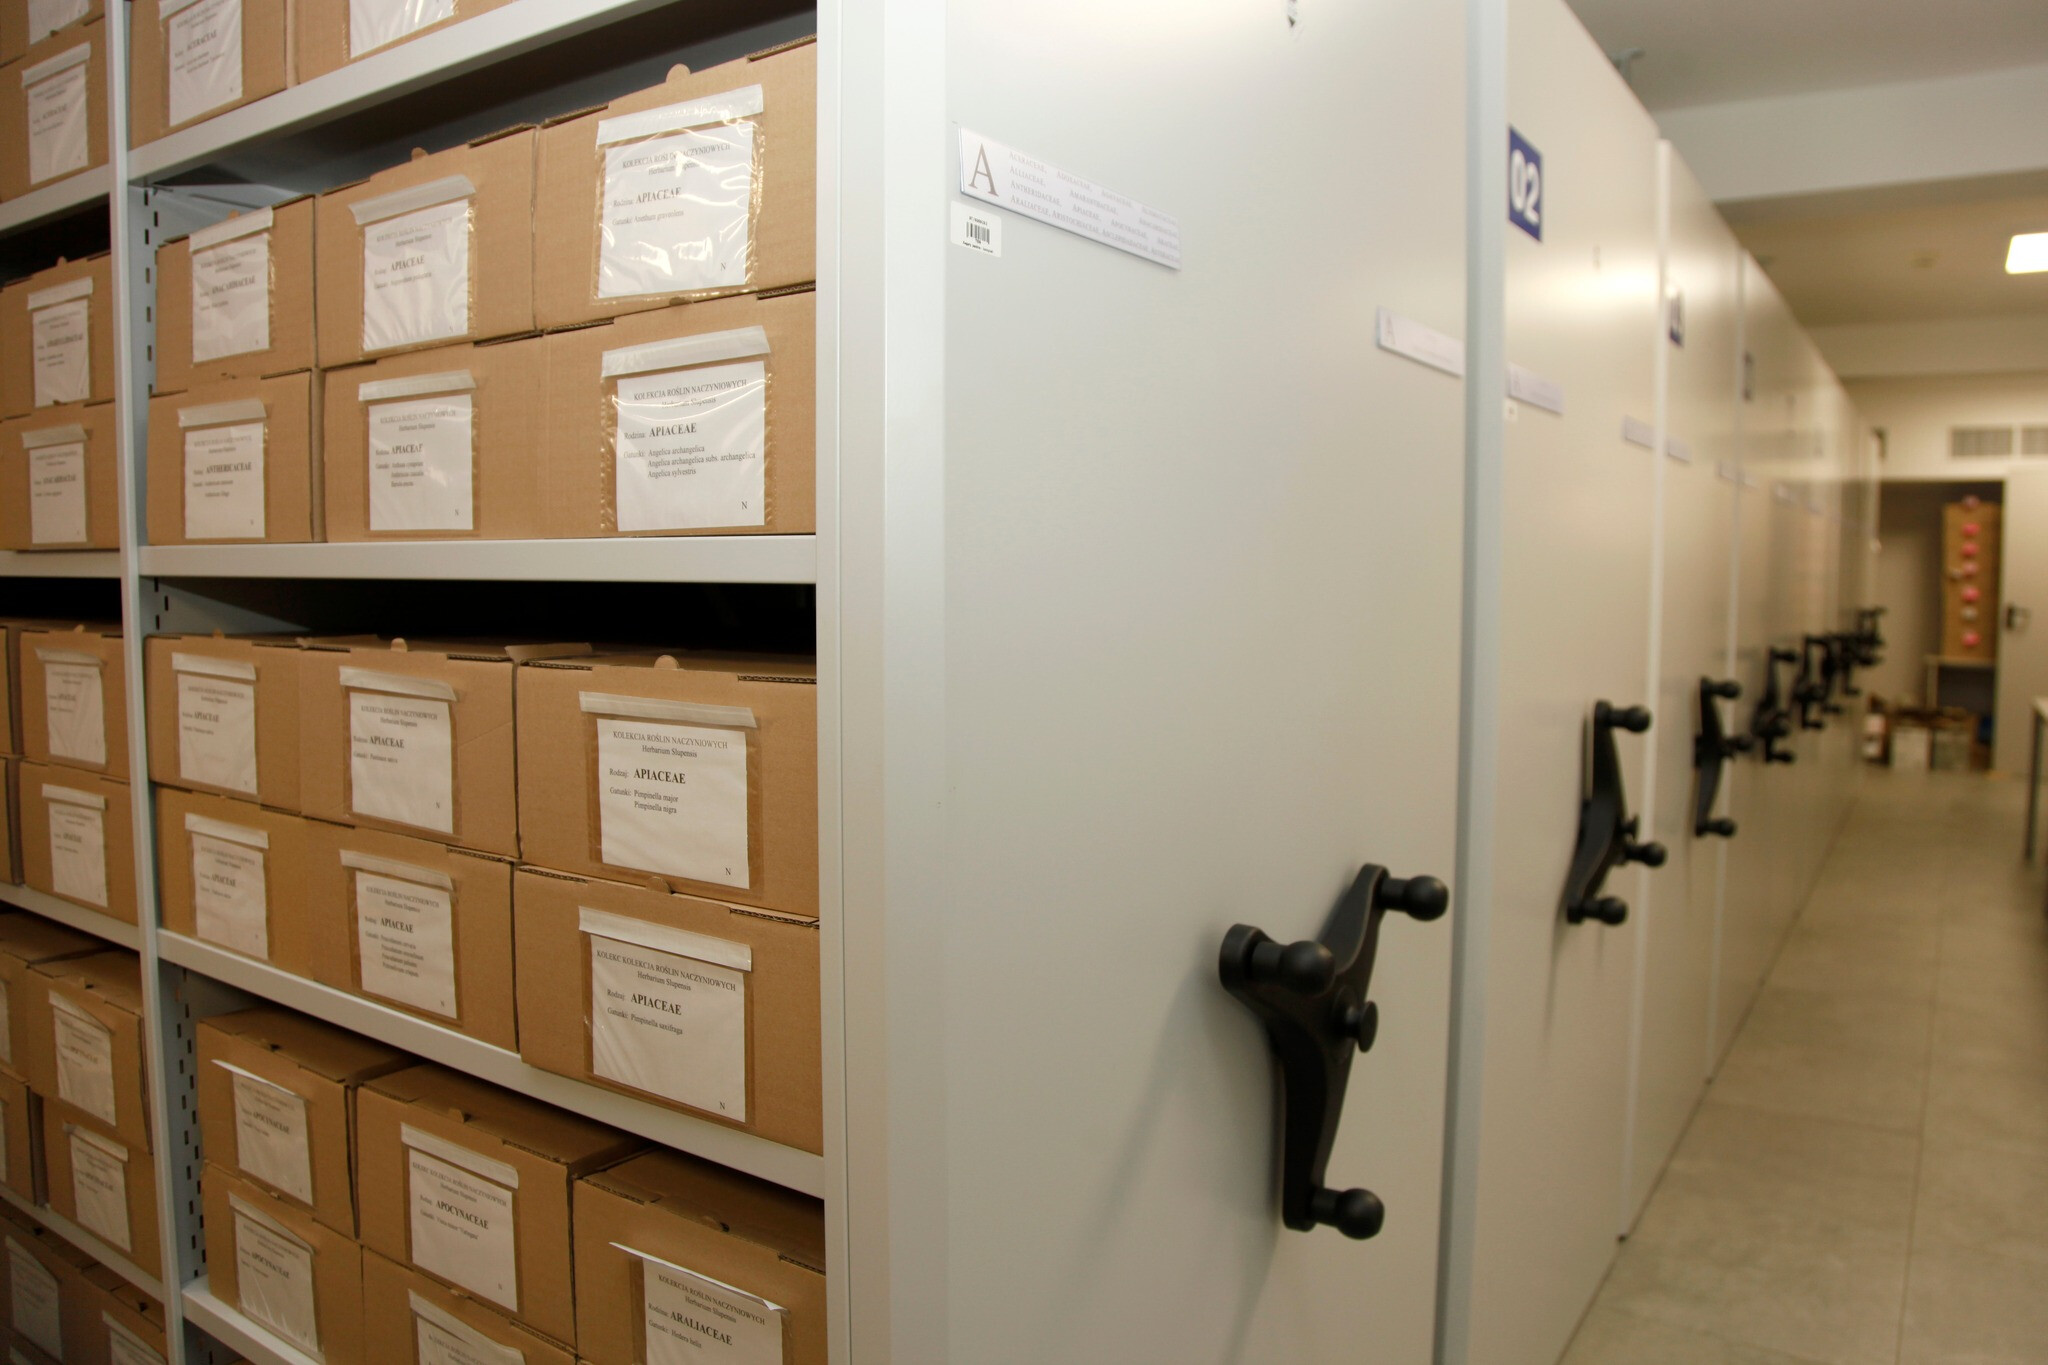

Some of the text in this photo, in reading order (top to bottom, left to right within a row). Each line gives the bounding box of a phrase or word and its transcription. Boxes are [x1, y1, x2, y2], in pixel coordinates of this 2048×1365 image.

[968, 143, 999, 197] A
[1511, 148, 1540, 224] 02
[636, 187, 682, 204] APIACEAE
[390, 255, 425, 272] APIACEAE
[720, 262, 727, 272] N
[634, 379, 747, 401] KOLEKCJA ROŚLIN NACZYNIOWYCH
[649, 423, 697, 437] APIACEAE
[391, 443, 424, 455] APIACEAE
[648, 449, 671, 459] Angelica
[671, 444, 705, 457] archangelica
[647, 451, 756, 469] Angelica archangelica subs. archangelica
[647, 467, 697, 480] Angelica sylvestris
[741, 501, 748, 510] N
[369, 735, 405, 749] APIACEAE
[613, 730, 728, 750] KOLEKCJA ROŚLIN NACZYNIOWYCH
[642, 744, 698, 759] Herbarium Slupensis
[609, 768, 686, 785] Rodzaj: APIACEAE
[633, 789, 662, 801] Pimpinella
[662, 792, 679, 804] major
[633, 800, 677, 815] Pimpinella nigra
[725, 867, 732, 876] N
[380, 917, 414, 935] APIACEAE
[596, 950, 736, 992] KOLEKC KOLEKCJA ROŚLIN NACZYNIOWYCH
[637, 971, 665, 986] Herbarium
[630, 993, 682, 1015] APIACEAE
[630, 1013, 658, 1029] Pimpinella
[659, 1020, 683, 1036] saxifraga
[719, 1101, 726, 1111] N
[435, 1199, 489, 1230] APOCYNACEAE
[658, 1274, 766, 1326] KOLEKCJA ROŚLIN NACZYNIOWYCH
[670, 1310, 733, 1346] ARALIACEAE
